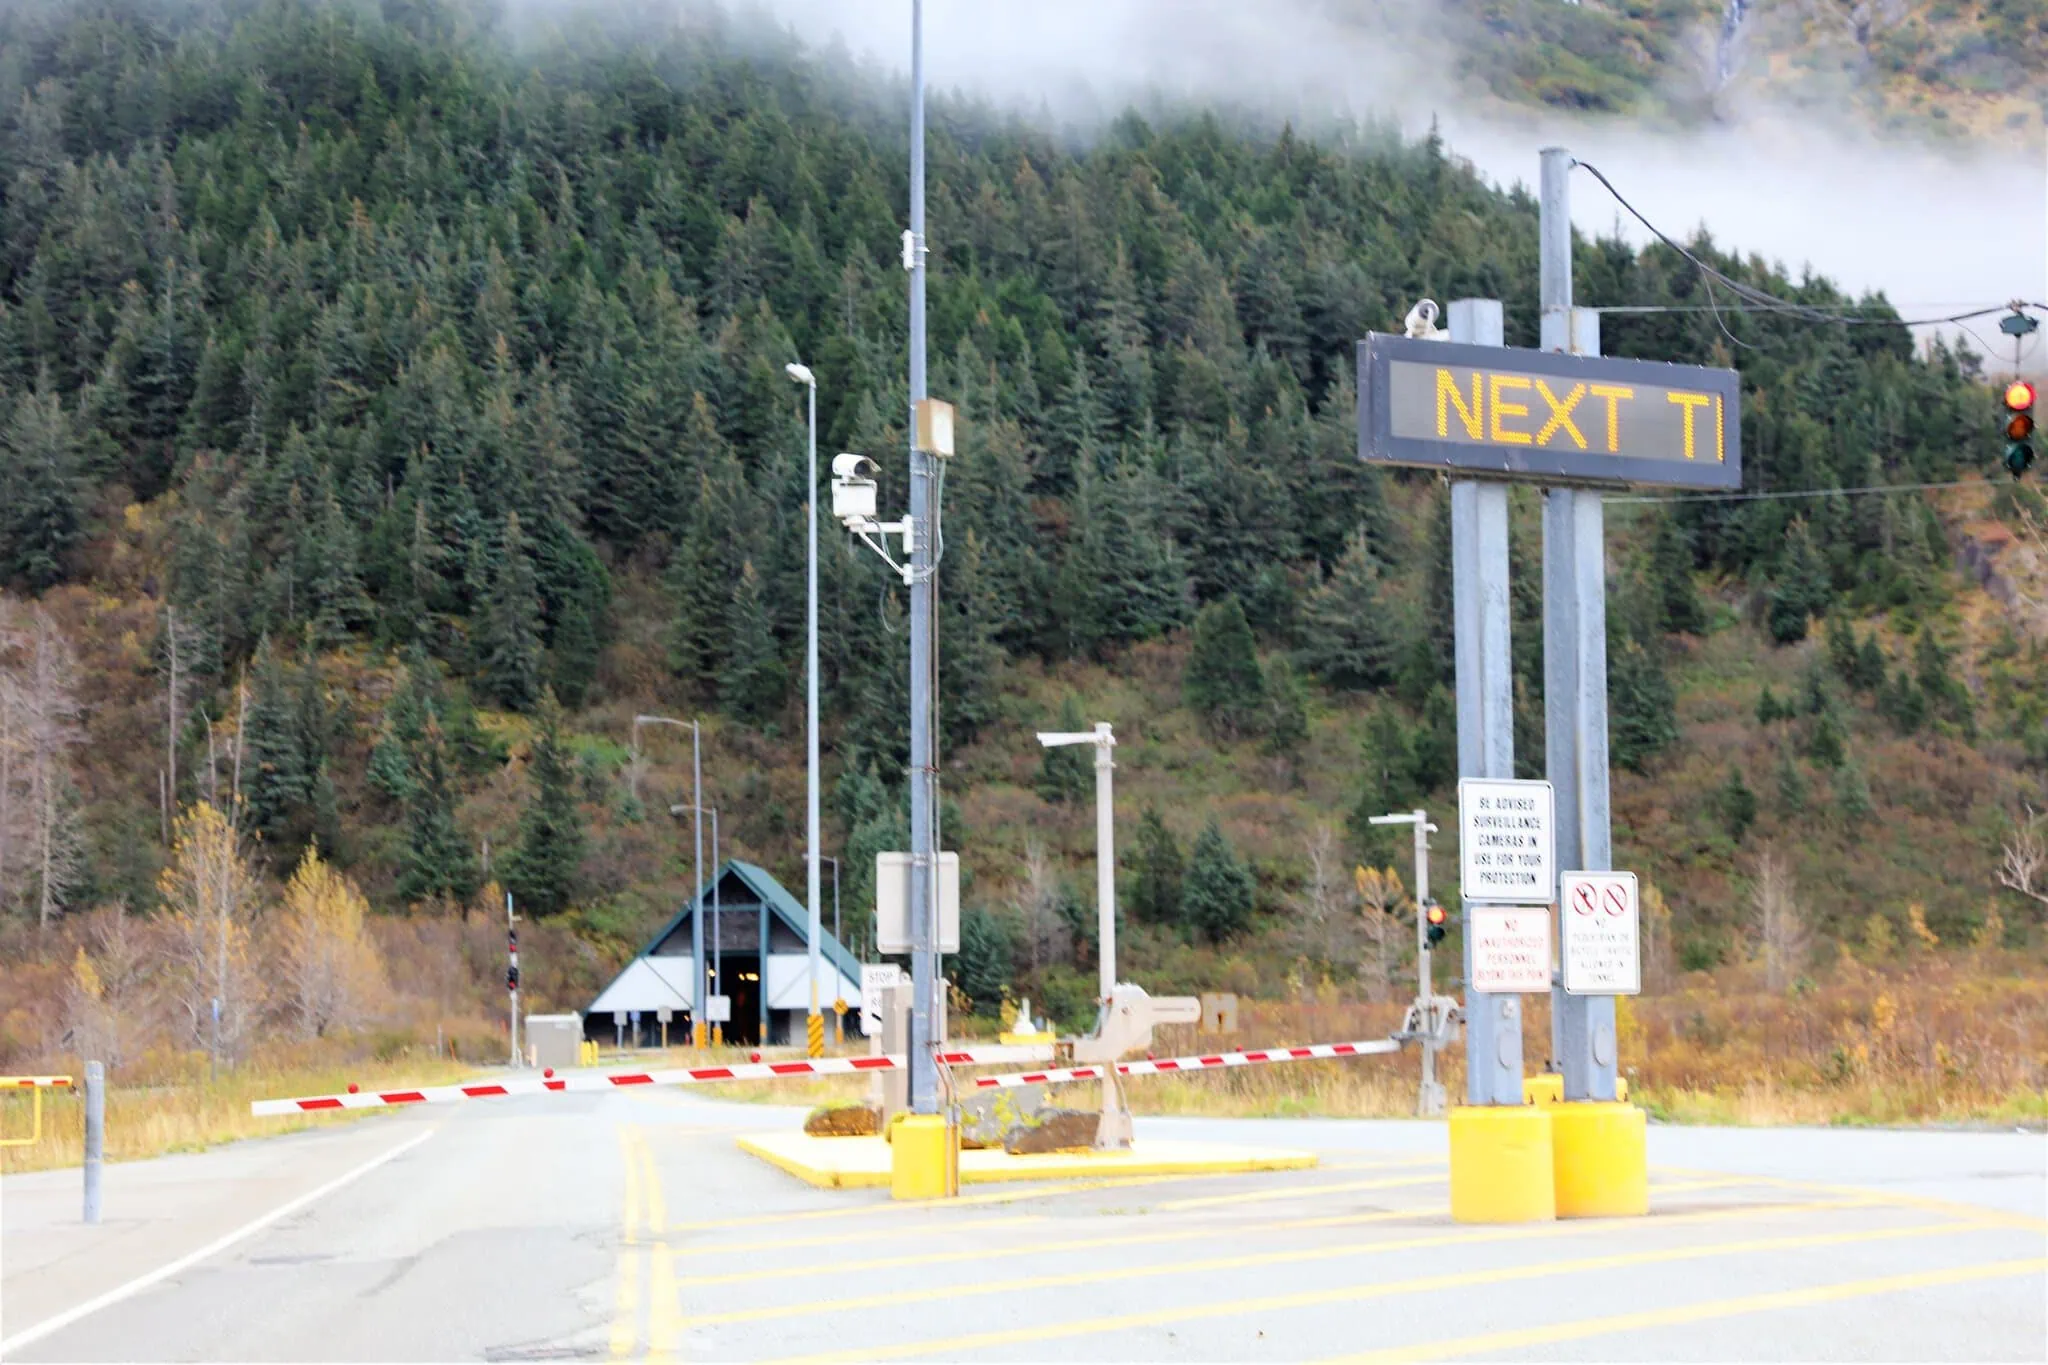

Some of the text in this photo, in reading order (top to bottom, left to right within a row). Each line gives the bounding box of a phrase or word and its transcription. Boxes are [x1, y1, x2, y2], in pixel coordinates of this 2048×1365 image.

[1436, 368, 1633, 453] NEXT
[1480, 797, 1535, 810] BE ADVISED
[1474, 815, 1541, 829] SURVEILLANCE
[1479, 834, 1537, 847] CAMERAS IN
[1474, 853, 1542, 866] USE FOR YOUR
[1480, 872, 1536, 884] PROTECTION
[1504, 919, 1520, 932] NO
